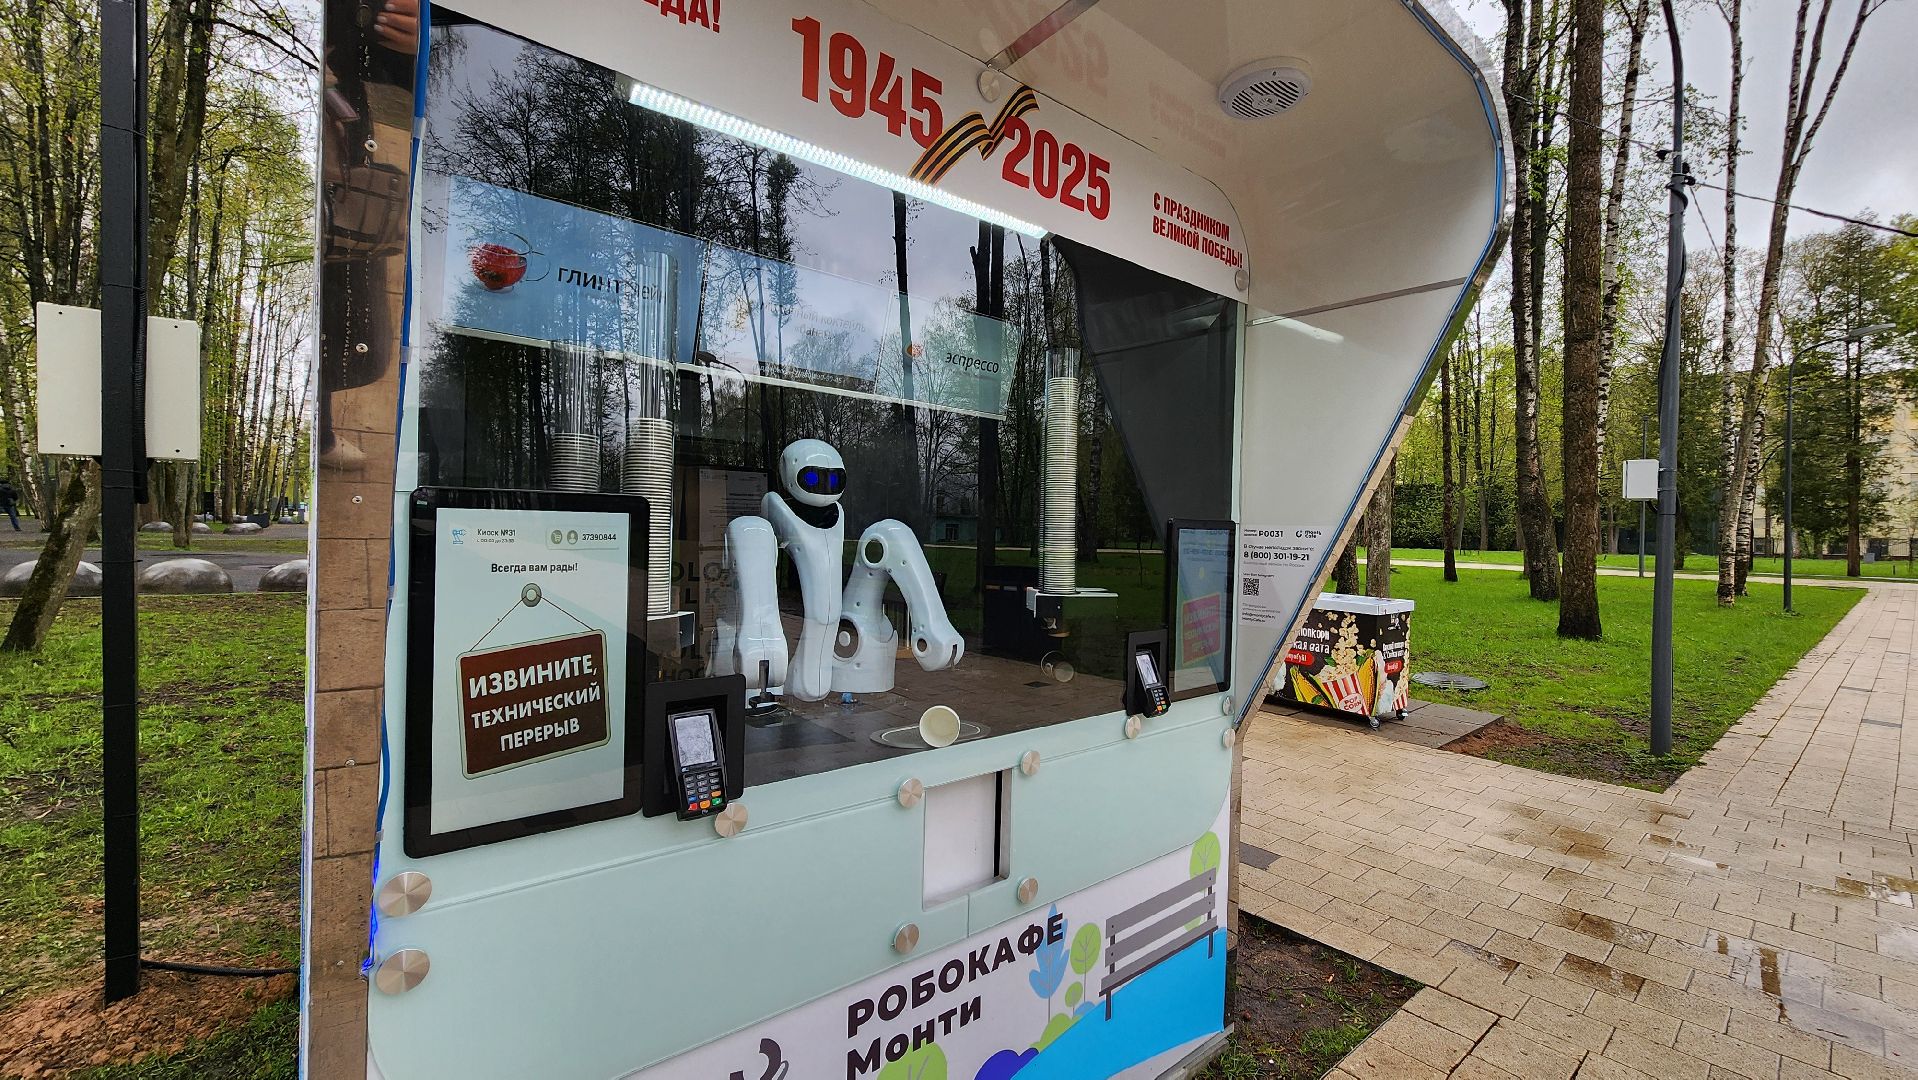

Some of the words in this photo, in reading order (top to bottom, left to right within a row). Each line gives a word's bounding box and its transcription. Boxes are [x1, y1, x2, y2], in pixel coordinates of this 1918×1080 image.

[791, 16, 943, 150] 1945
[1002, 116, 1111, 221] 2025
[1153, 192, 1160, 211] С
[1163, 196, 1230, 242] ПРАЗДНИКОМ
[1152, 215, 1200, 251] ВЕЛИКОЙ
[1201, 236, 1243, 269] ПОБЕДЫ!
[945, 352, 1000, 374] эспрессо
[477, 528, 499, 537] Киоск
[500, 528, 516, 537] №31
[1250, 550, 1272, 561] (800)
[1273, 552, 1310, 561] 301-19-21
[491, 562, 527, 574] Всегда
[528, 562, 548, 573] вам
[550, 562, 579, 574] рады!
[1309, 642, 1330, 654] вата
[468, 653, 598, 700] ИЗВИНИТЕ,
[471, 682, 602, 730] ТЕХНИЧЕСКИЙ
[500, 717, 581, 753] ПЕРЕРЫВ
[847, 912, 1064, 1039] РОБОКАФЕ
